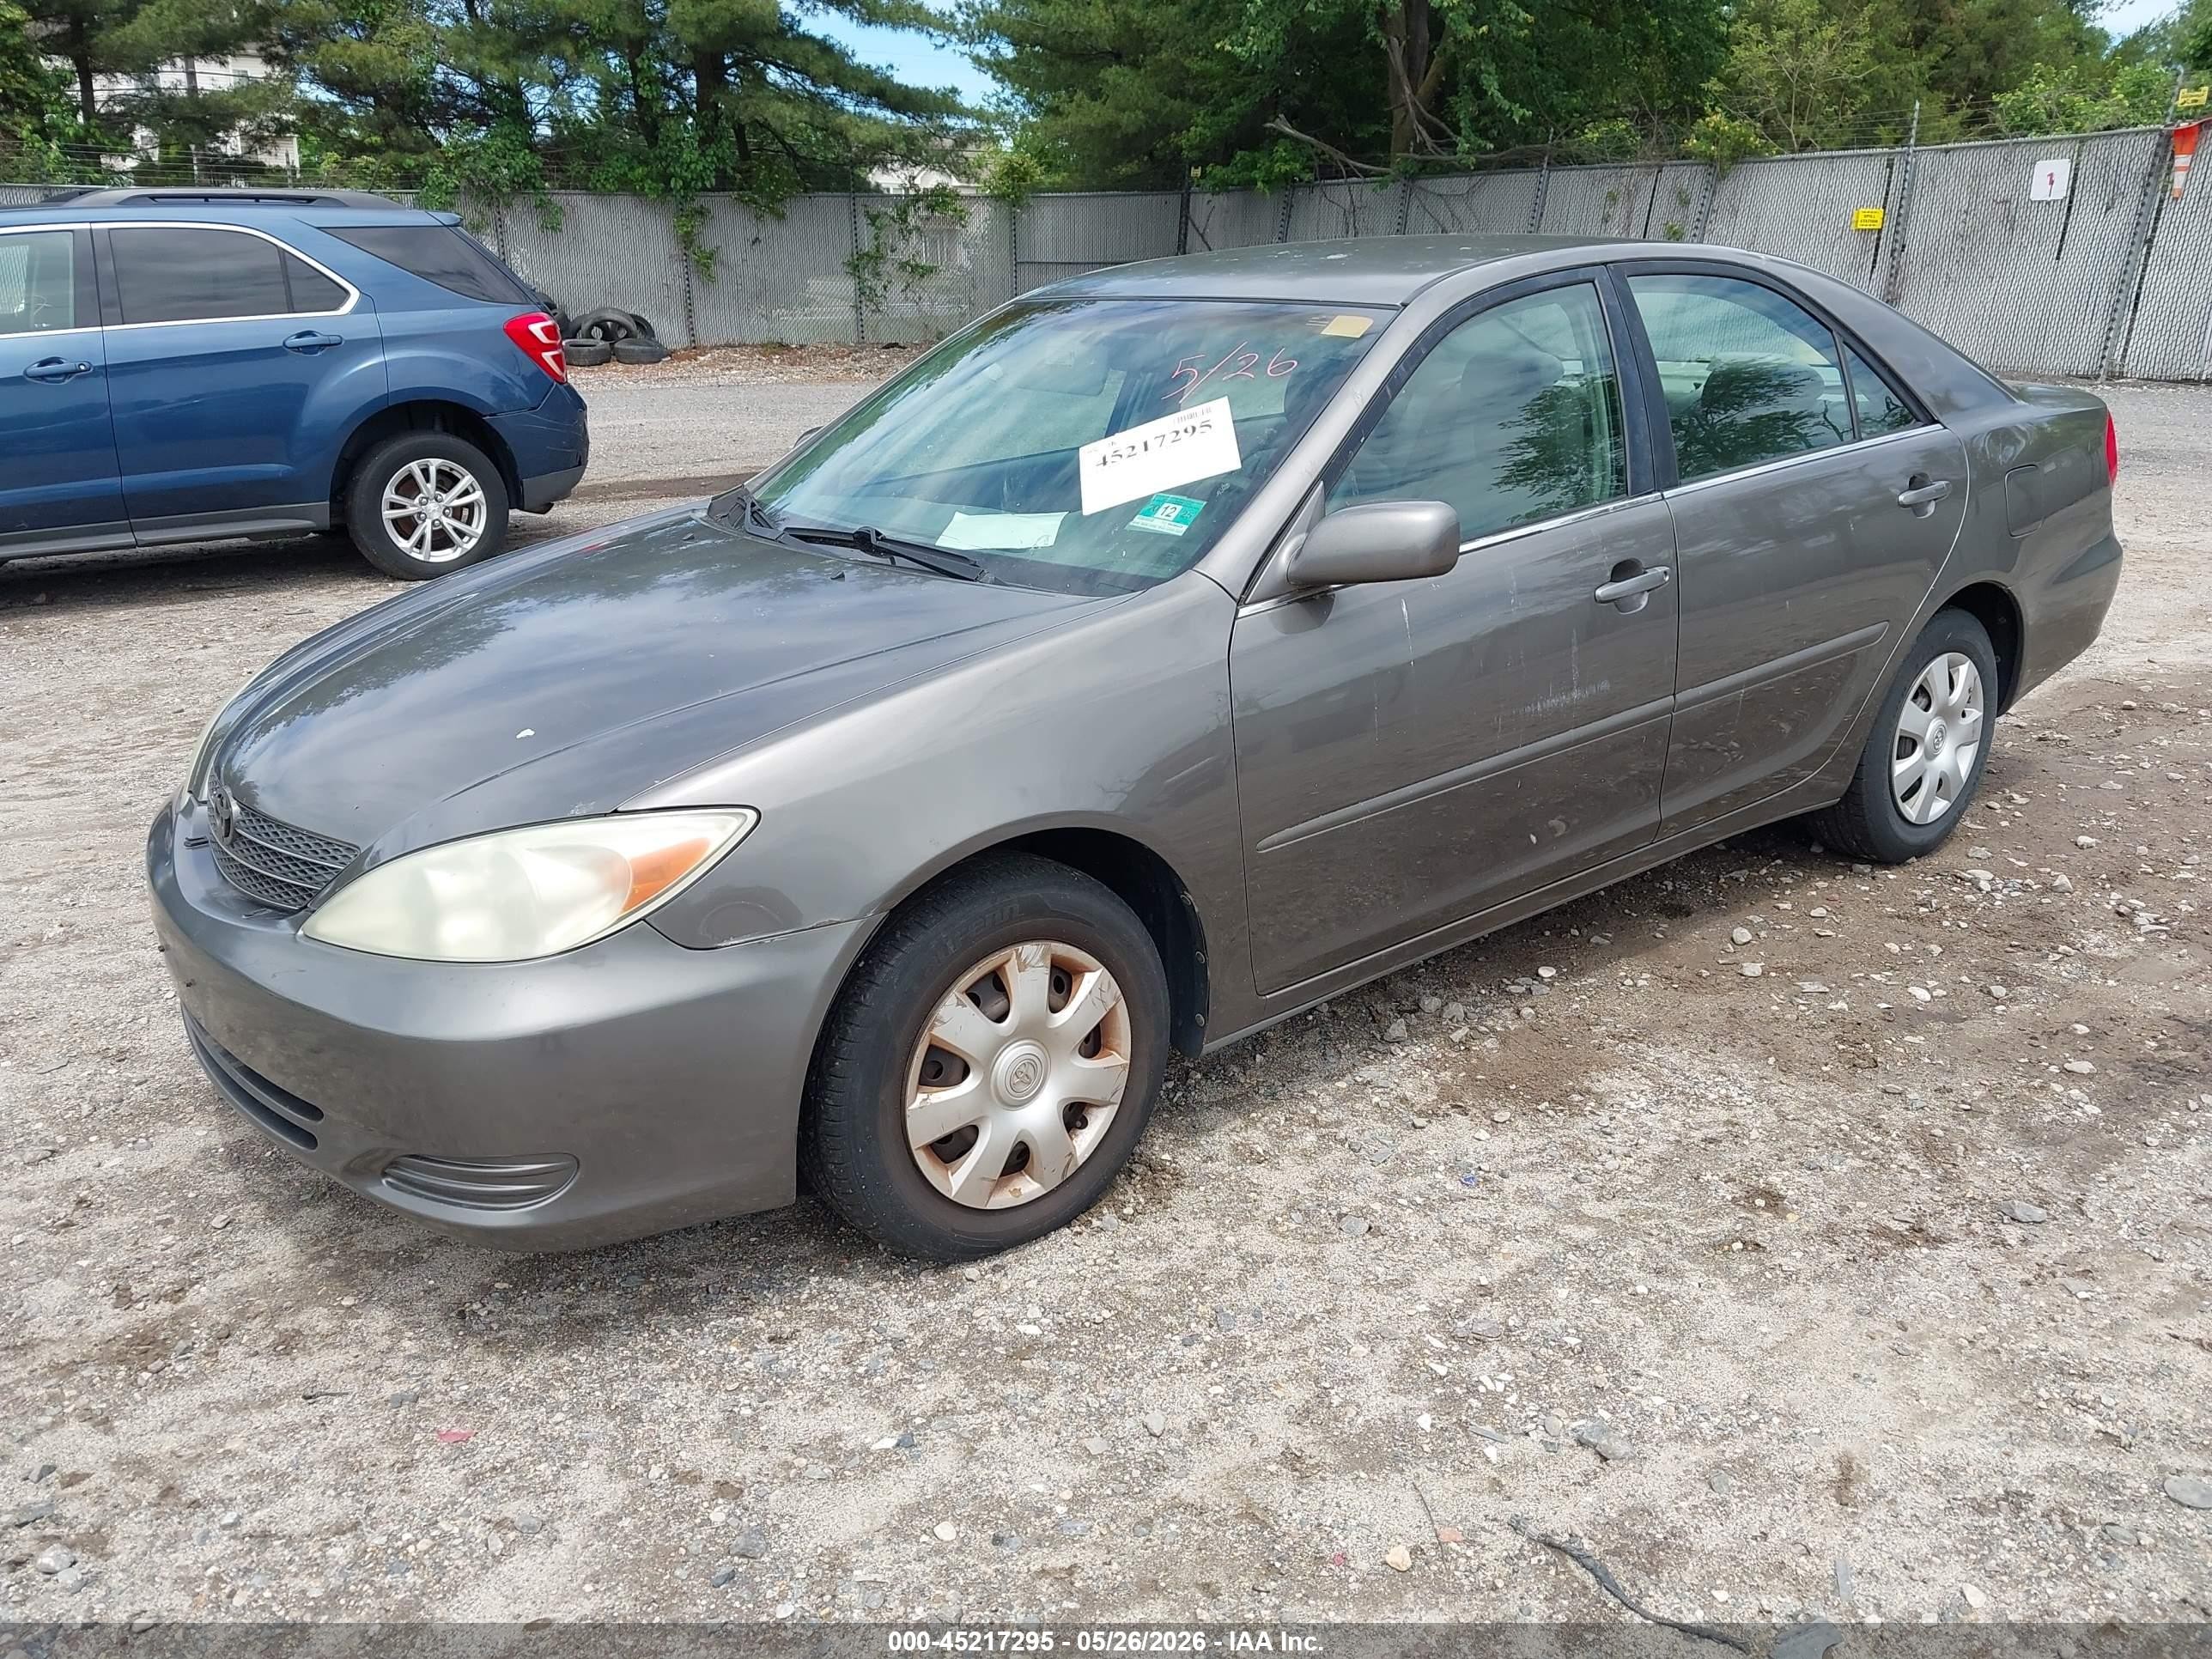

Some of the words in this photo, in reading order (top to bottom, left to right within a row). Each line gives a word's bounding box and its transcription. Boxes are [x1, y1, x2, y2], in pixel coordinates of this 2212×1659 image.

[1161, 342, 1298, 404] 5/26
[1095, 418, 1213, 467] 45217295
[1159, 505, 1177, 517] 12
